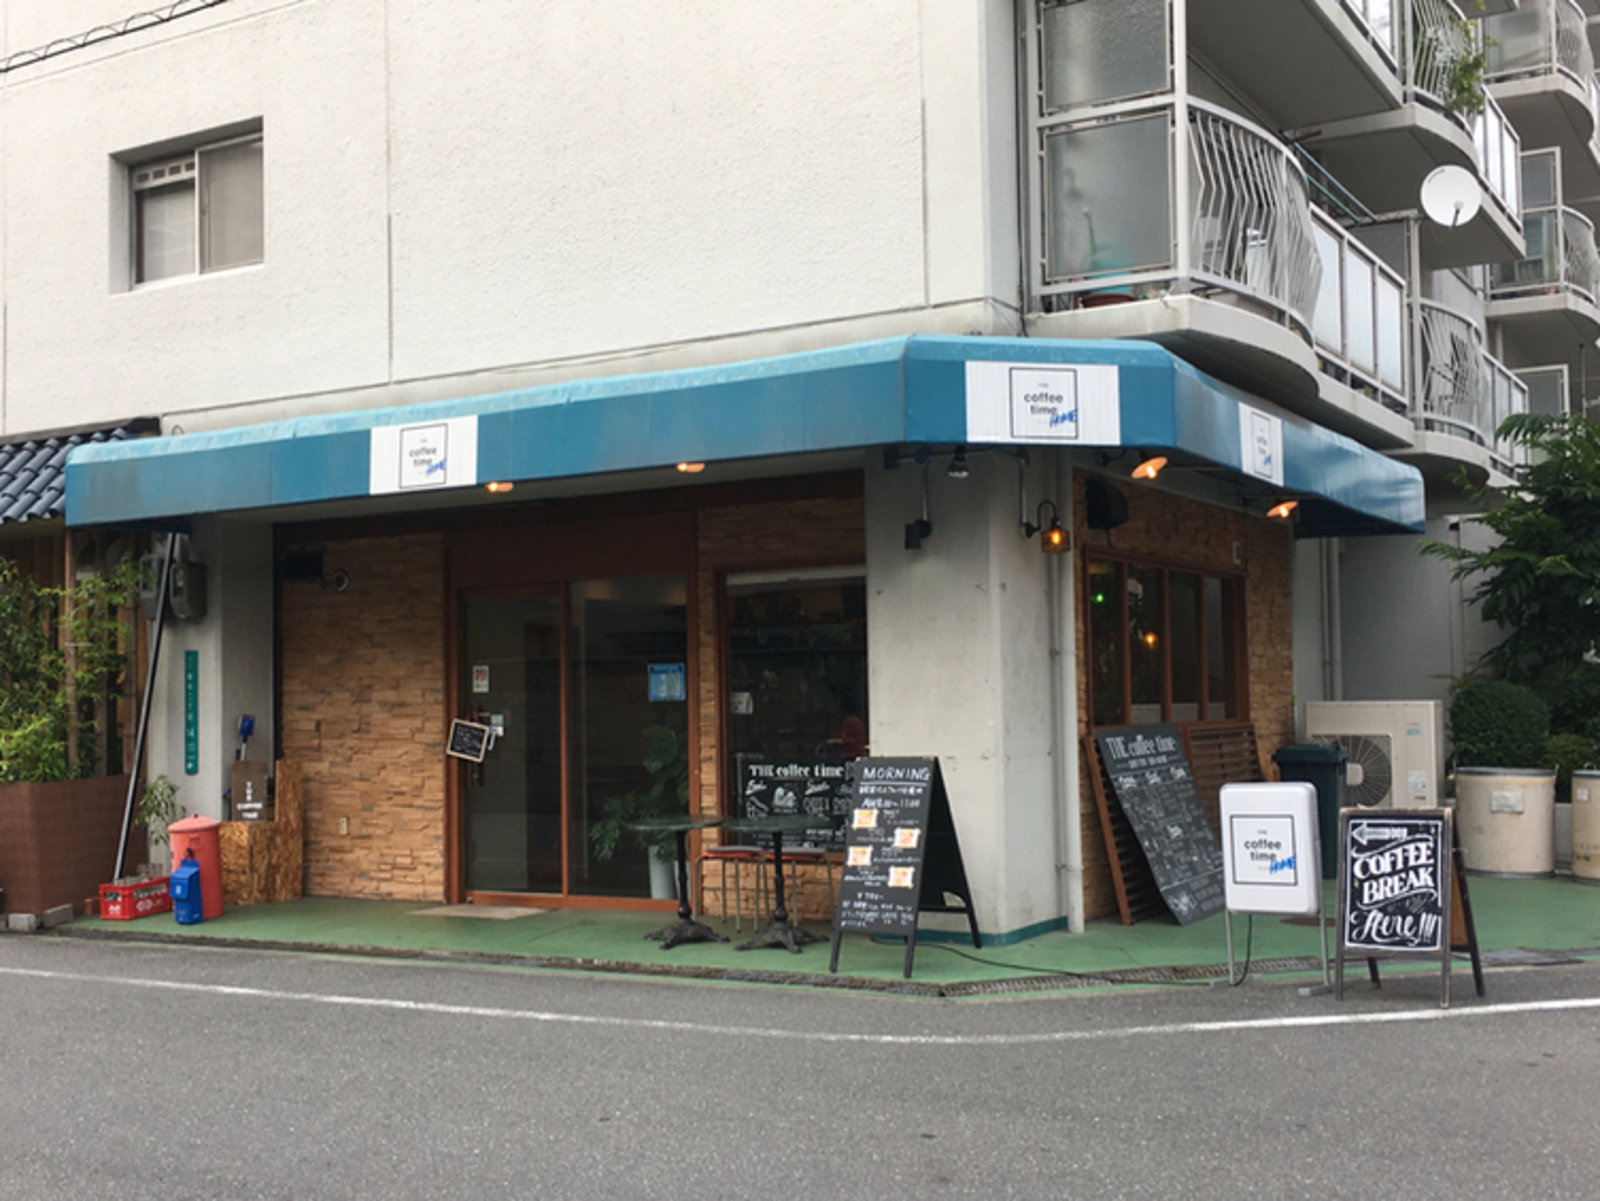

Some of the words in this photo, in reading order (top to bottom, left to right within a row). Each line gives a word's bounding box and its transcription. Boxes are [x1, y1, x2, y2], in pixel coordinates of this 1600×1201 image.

[1024, 391, 1064, 403] coffee
[1030, 404, 1058, 415] time
[409, 446, 437, 457] coffee
[1105, 736, 1129, 760] THE
[1128, 734, 1157, 757] coffee
[749, 764, 775, 777] THE
[776, 763, 810, 777] coffee
[814, 763, 844, 777] time
[863, 766, 930, 780] MORNING
[1244, 838, 1281, 850] coffee
[1250, 851, 1276, 861] time
[1353, 842, 1434, 879] COFFEE
[1363, 867, 1435, 904] BREAK
